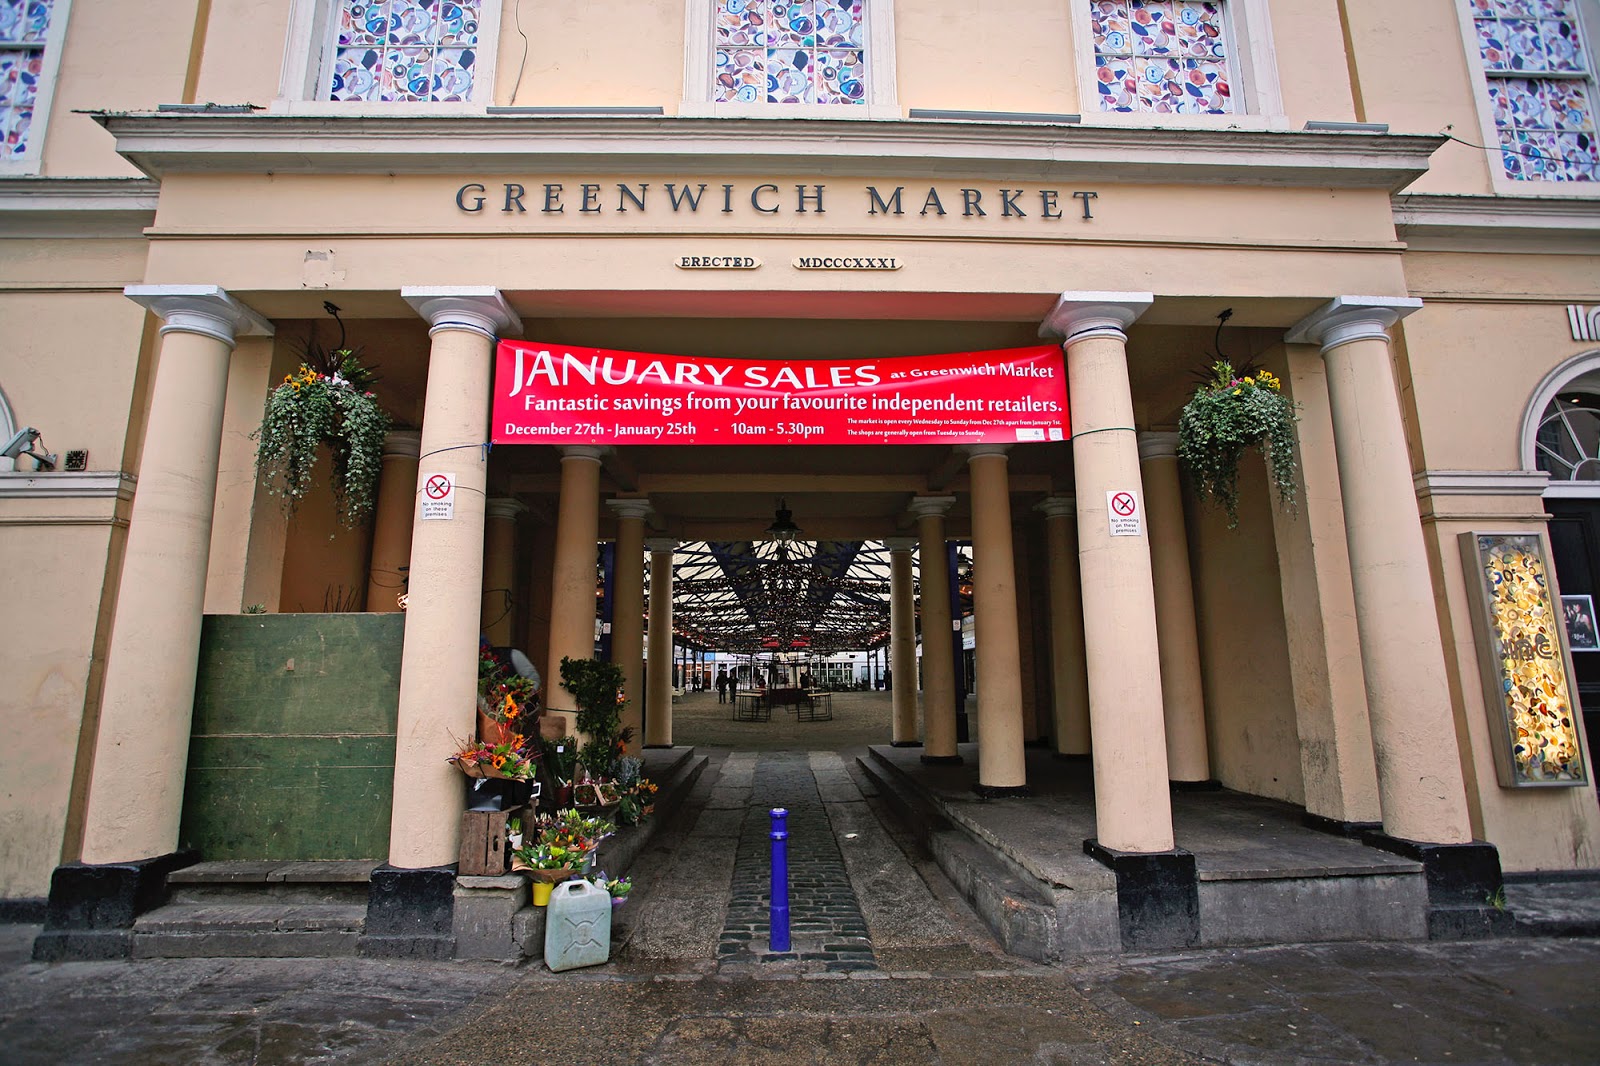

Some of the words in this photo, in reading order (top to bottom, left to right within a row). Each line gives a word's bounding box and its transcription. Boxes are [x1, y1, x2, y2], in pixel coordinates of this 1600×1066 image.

[456, 183, 826, 214] GREENWICH
[867, 186, 1099, 219] MARKET
[681, 257, 755, 268] ERECTED
[799, 257, 897, 269] MDCCCXXXI
[509, 350, 733, 397] JANUARY
[744, 366, 880, 388] SALES
[890, 371, 906, 379] at
[910, 363, 995, 378] Greenwich
[999, 362, 1054, 378] Market
[525, 394, 608, 411] Fantastic
[613, 393, 682, 416] savings
[686, 392, 730, 410] from
[734, 396, 777, 416] your
[783, 392, 867, 411] favourite
[872, 393, 984, 416] independent
[988, 395, 1062, 412] retailers.
[506, 422, 572, 435] December
[575, 423, 604, 435] 27th
[614, 422, 663, 438] January
[667, 422, 696, 435] 25th
[731, 422, 765, 434] 10am
[777, 422, 824, 438] 5.30pm
[1033, 419, 1052, 427] January
